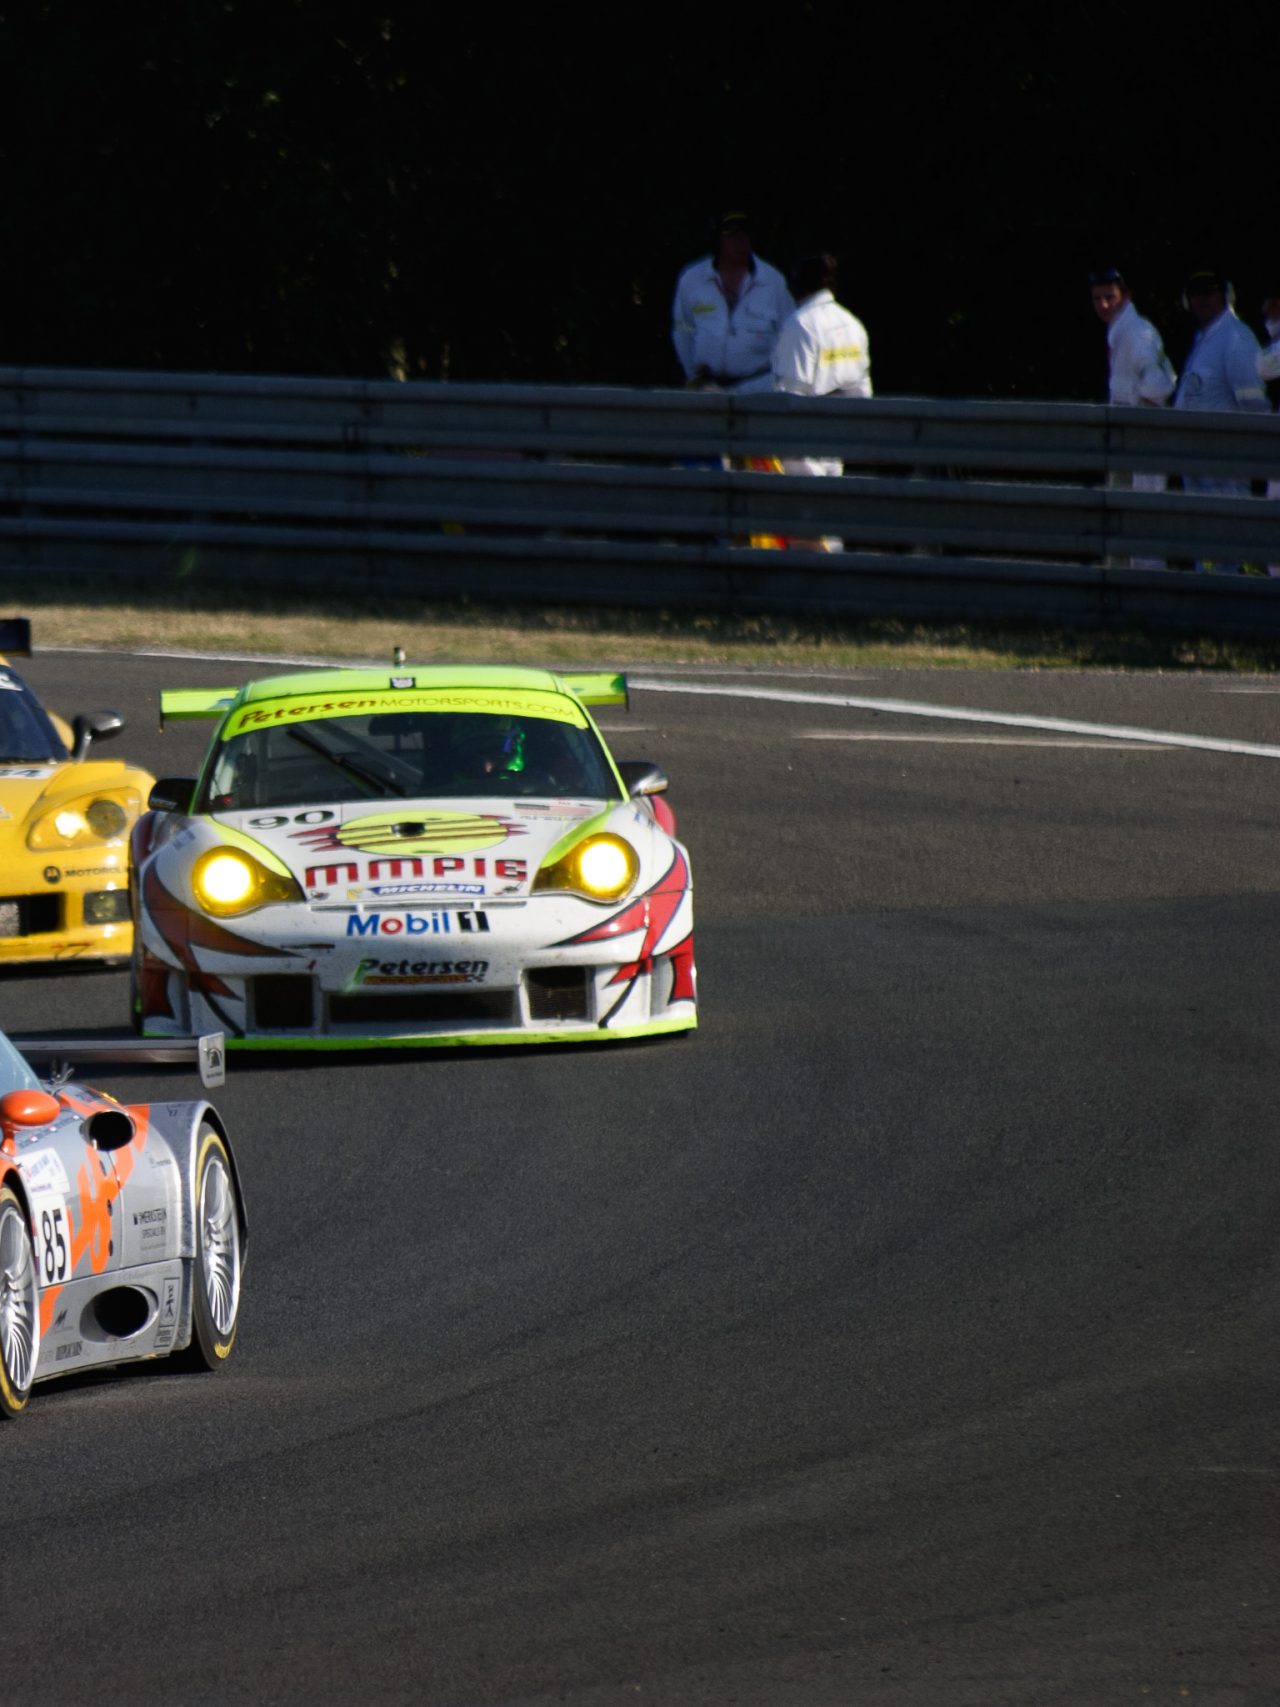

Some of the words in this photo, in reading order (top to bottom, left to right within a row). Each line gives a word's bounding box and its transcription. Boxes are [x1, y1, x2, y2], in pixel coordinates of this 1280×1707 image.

[248, 810, 336, 830] 90
[379, 884, 483, 895] MICHELIN
[346, 911, 451, 937] Mobil
[356, 958, 489, 978] Petersen
[41, 1207, 66, 1284] 85
